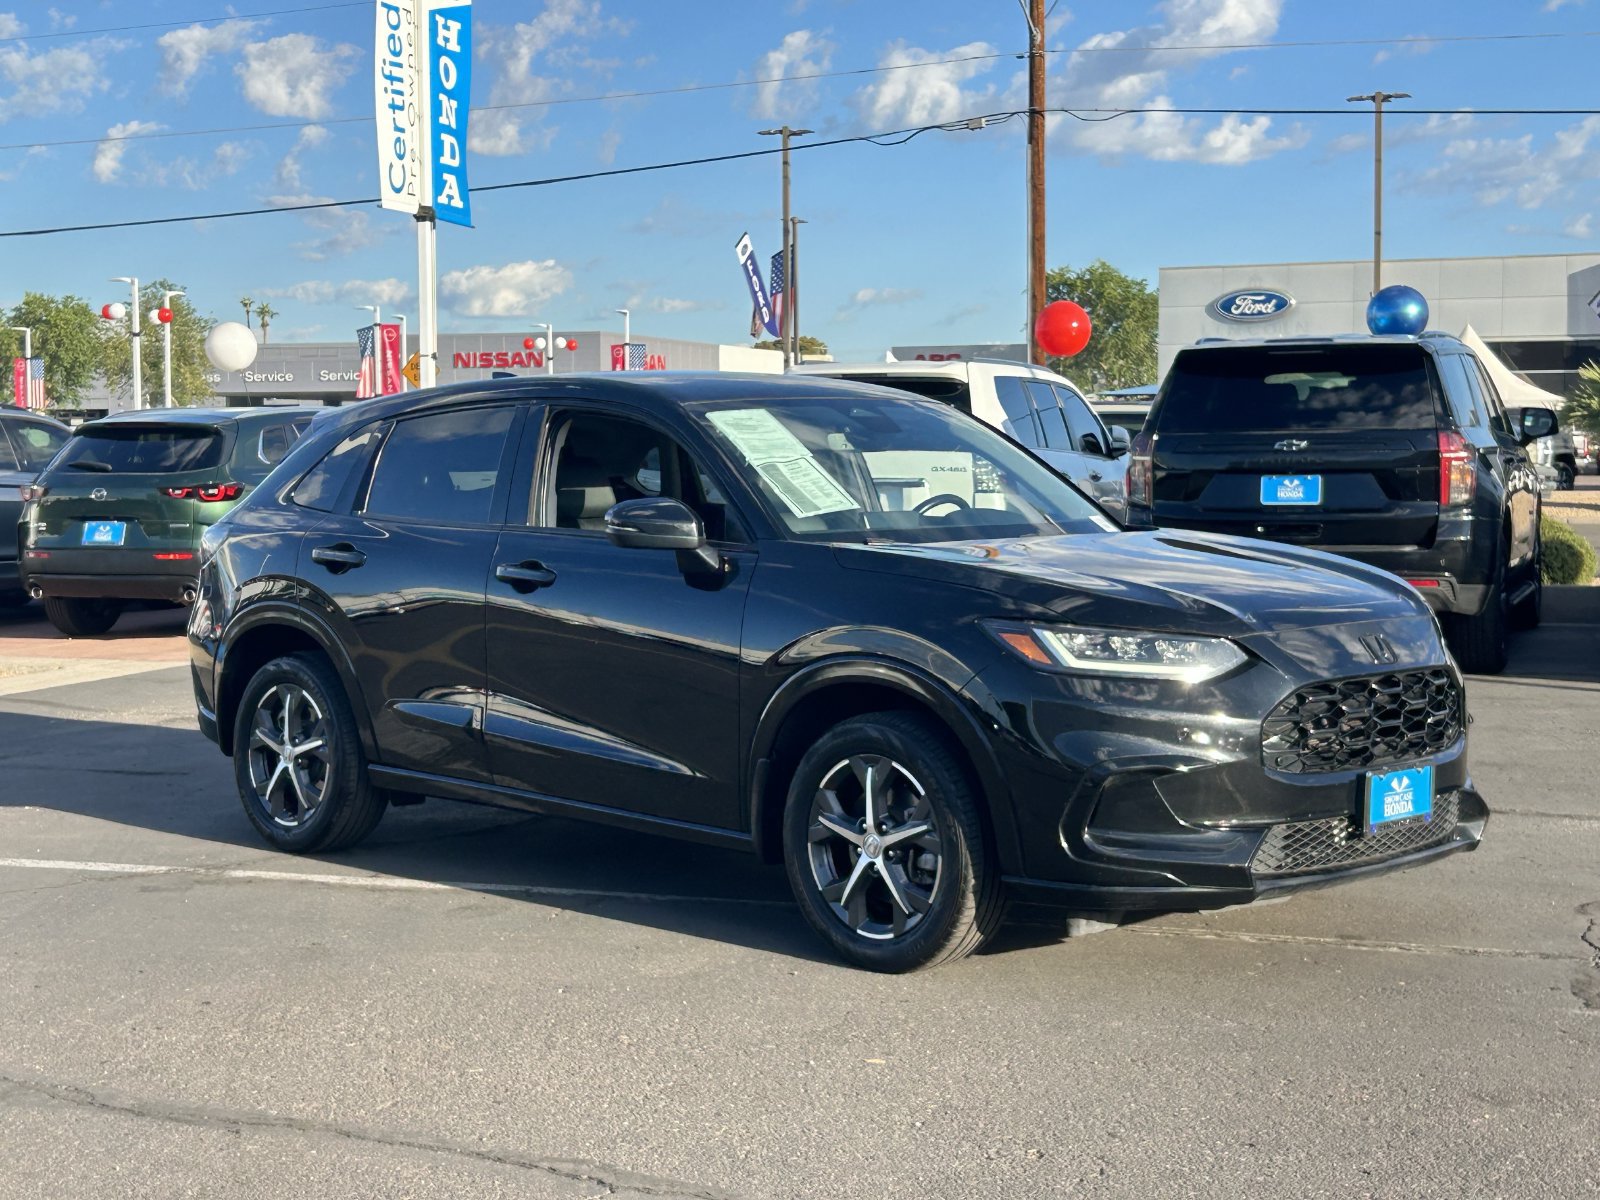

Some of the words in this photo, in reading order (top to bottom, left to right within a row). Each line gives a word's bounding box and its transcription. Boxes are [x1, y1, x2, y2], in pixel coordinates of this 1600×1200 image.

[380, 1, 407, 194] Certified
[435, 13, 464, 209] HONDA
[1230, 295, 1277, 315] Ford
[453, 351, 545, 368] NISSAN
[244, 370, 294, 382] Service
[319, 369, 362, 381] Servic
[1383, 800, 1414, 817] HONDA
